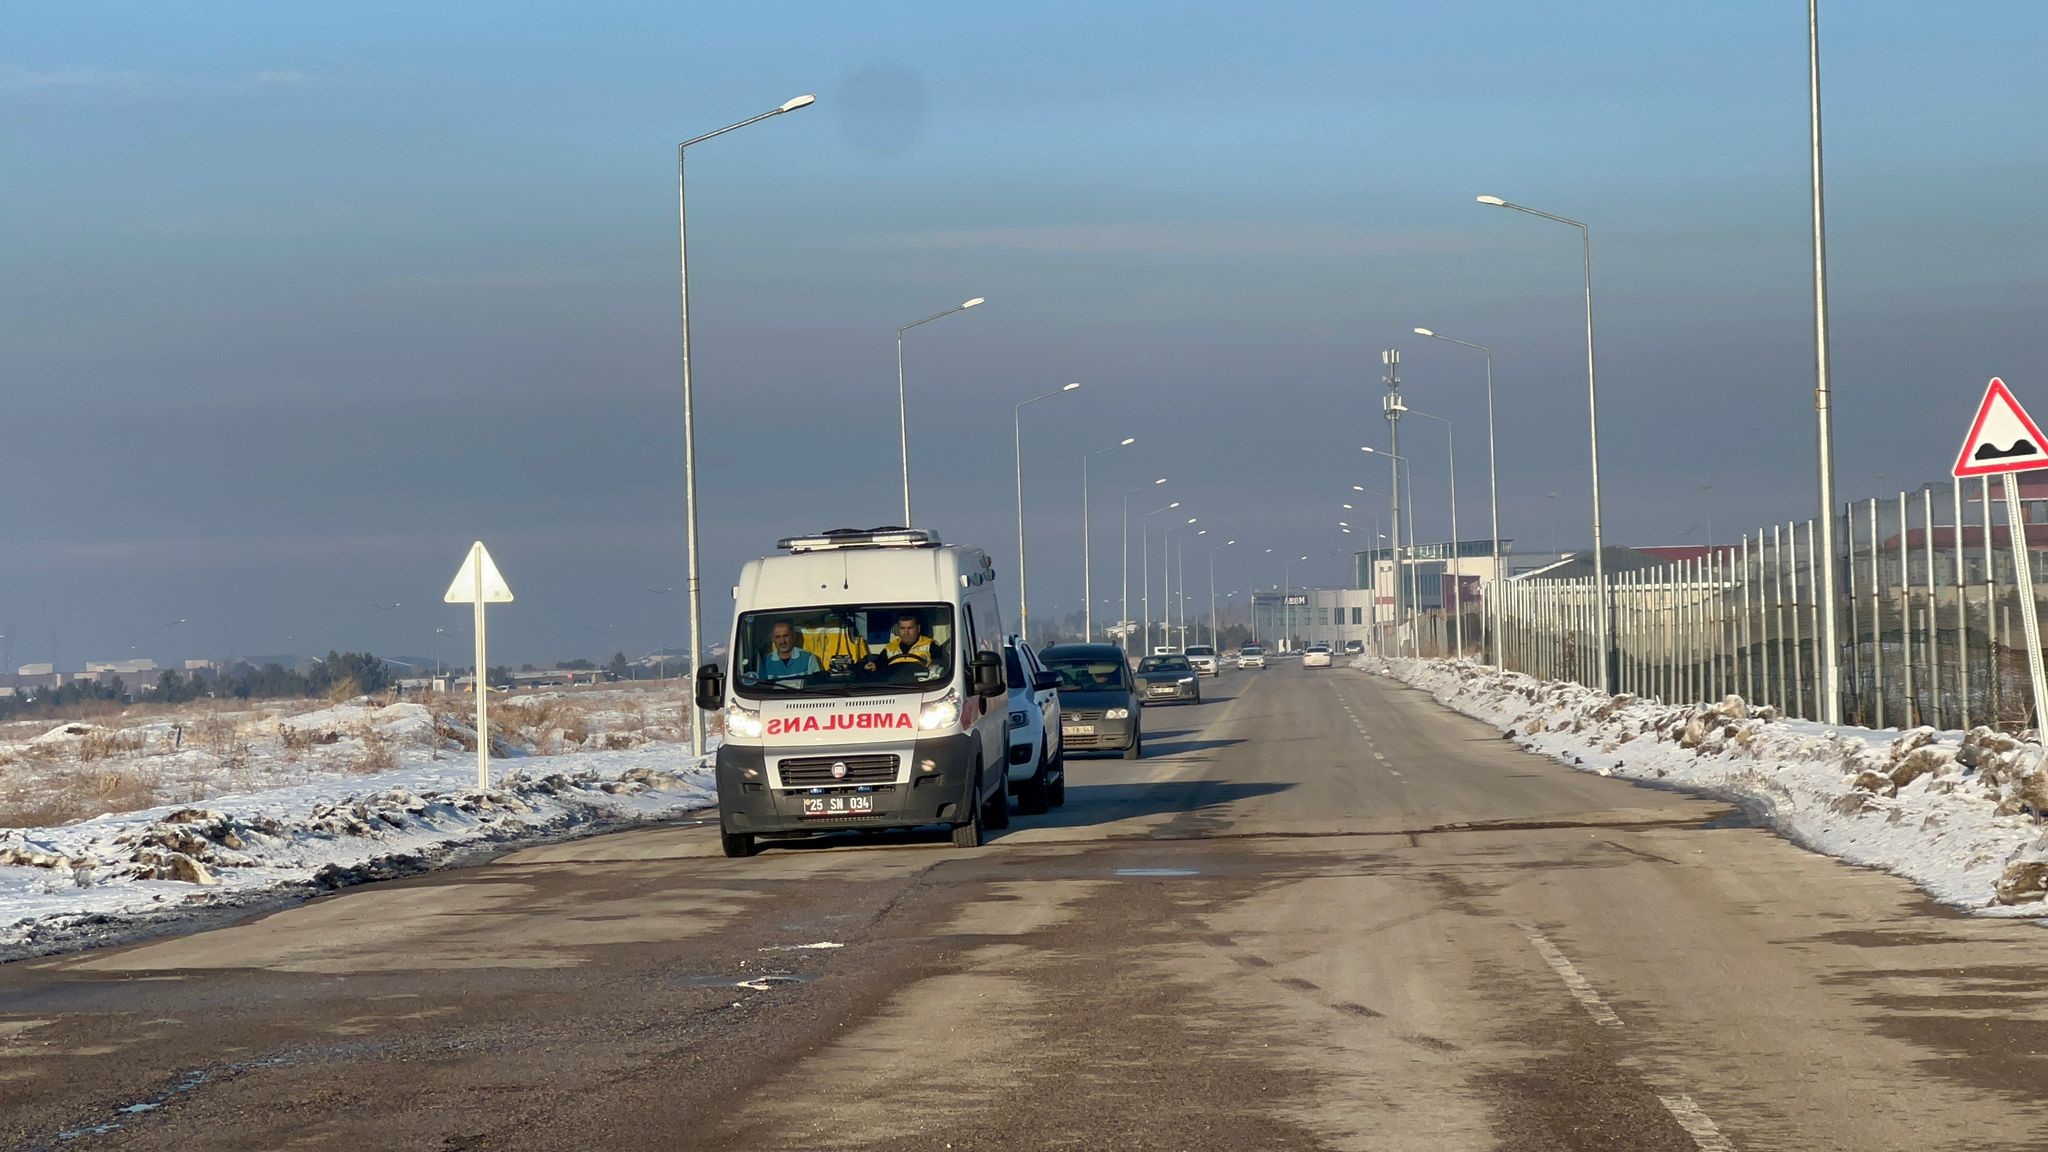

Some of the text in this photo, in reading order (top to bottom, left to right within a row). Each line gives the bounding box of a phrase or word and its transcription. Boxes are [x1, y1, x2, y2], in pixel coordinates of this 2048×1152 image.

[810, 797, 869, 811] 25 SN 034
